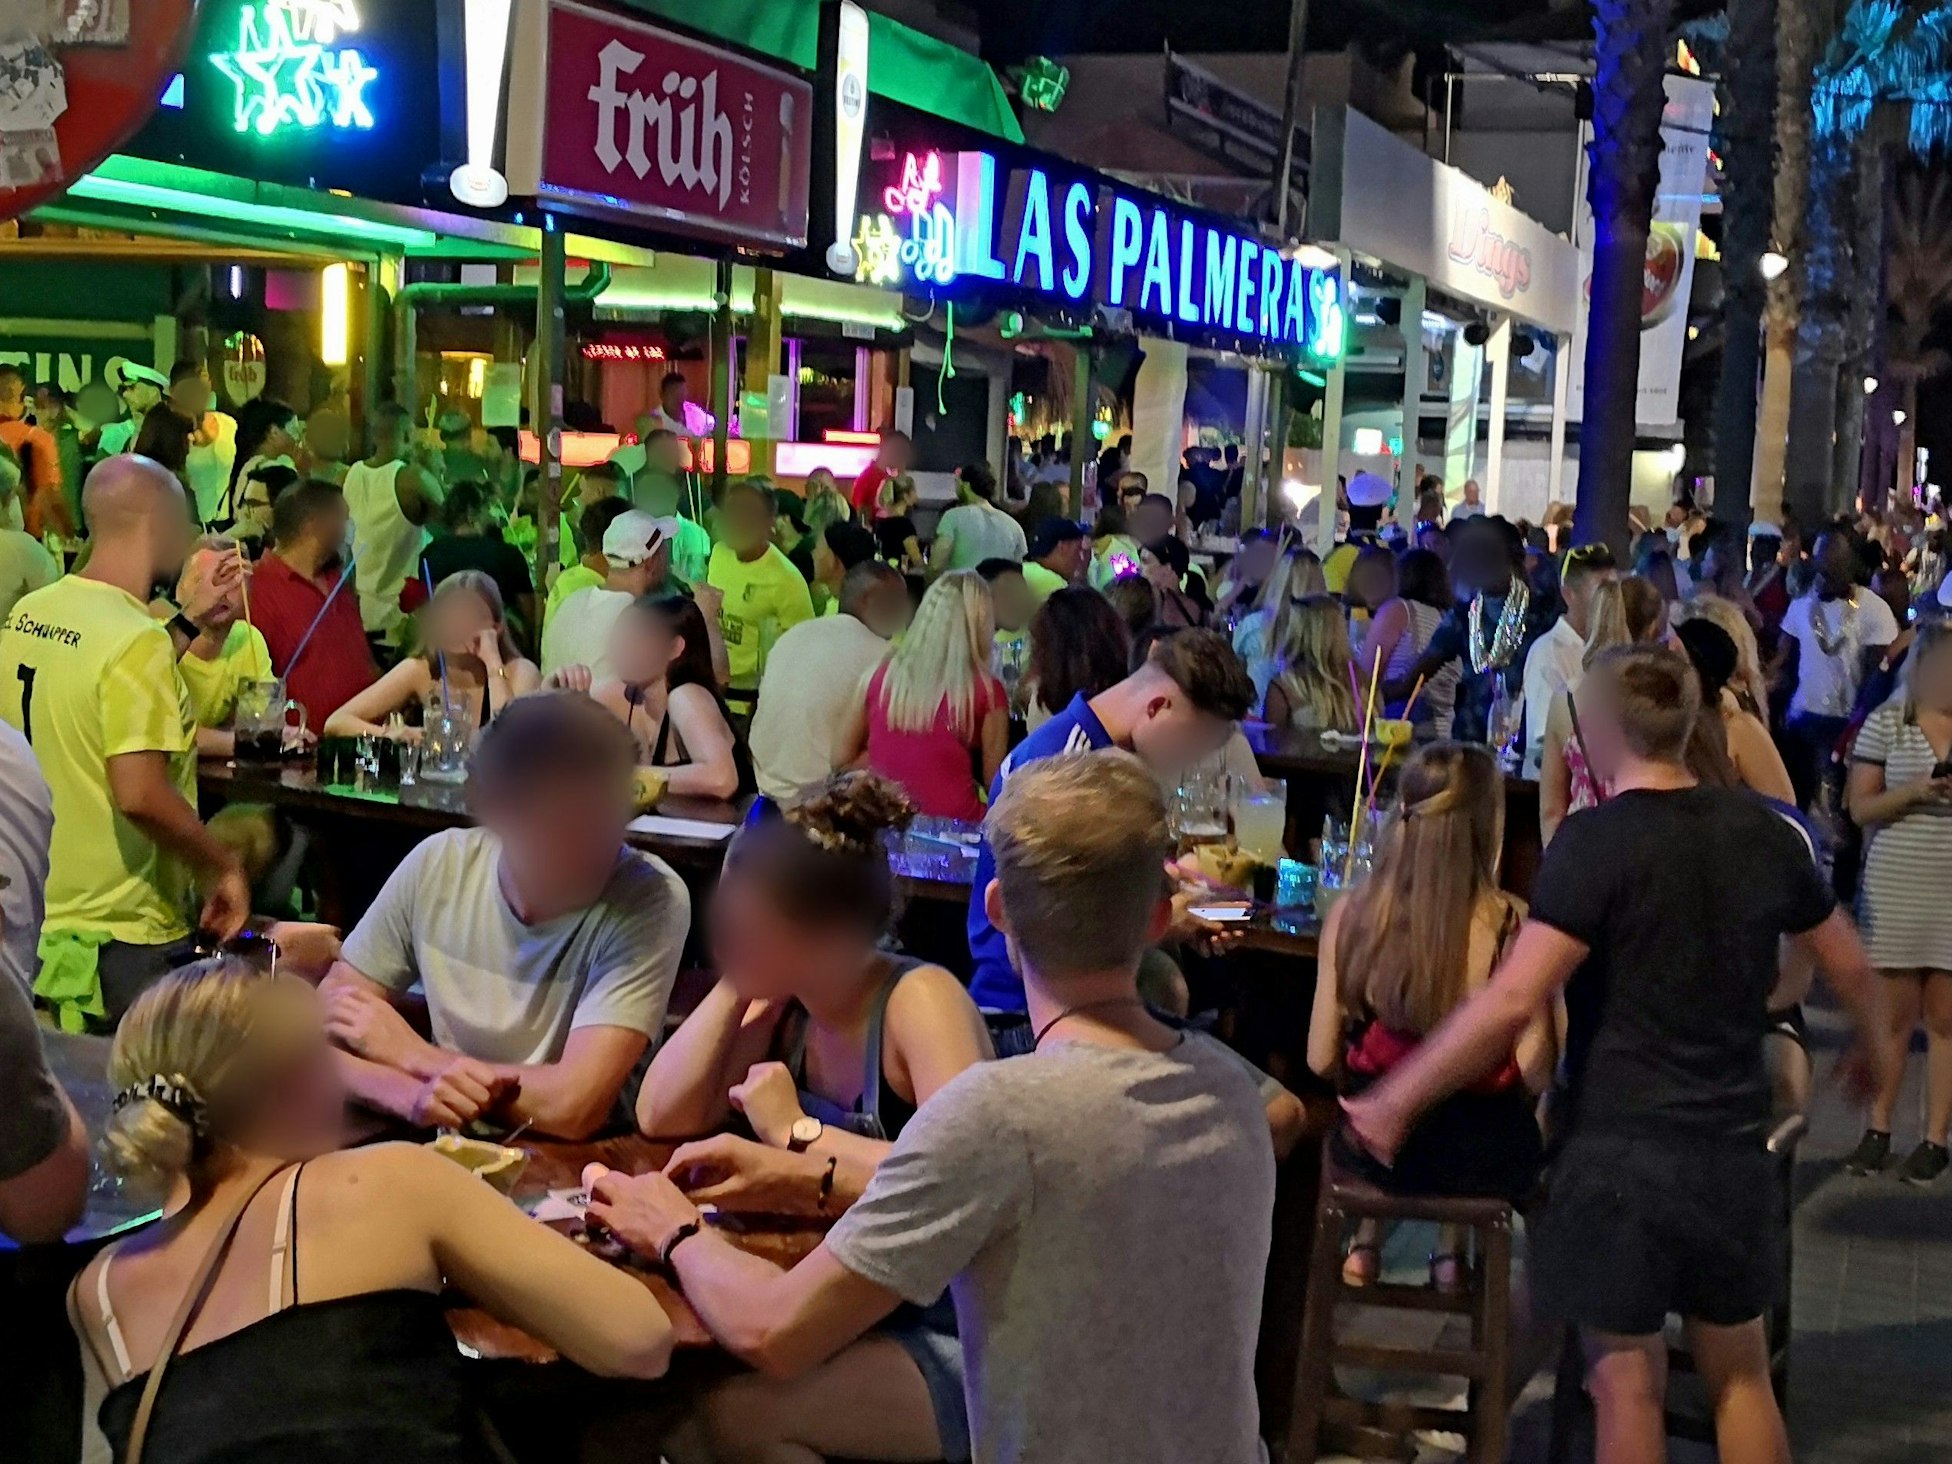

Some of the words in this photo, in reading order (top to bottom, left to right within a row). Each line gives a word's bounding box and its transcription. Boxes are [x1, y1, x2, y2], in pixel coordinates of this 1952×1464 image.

[972, 151, 1092, 298] LAS
[1110, 196, 1328, 349] PALMERAS
[1447, 194, 1531, 299] Dings
